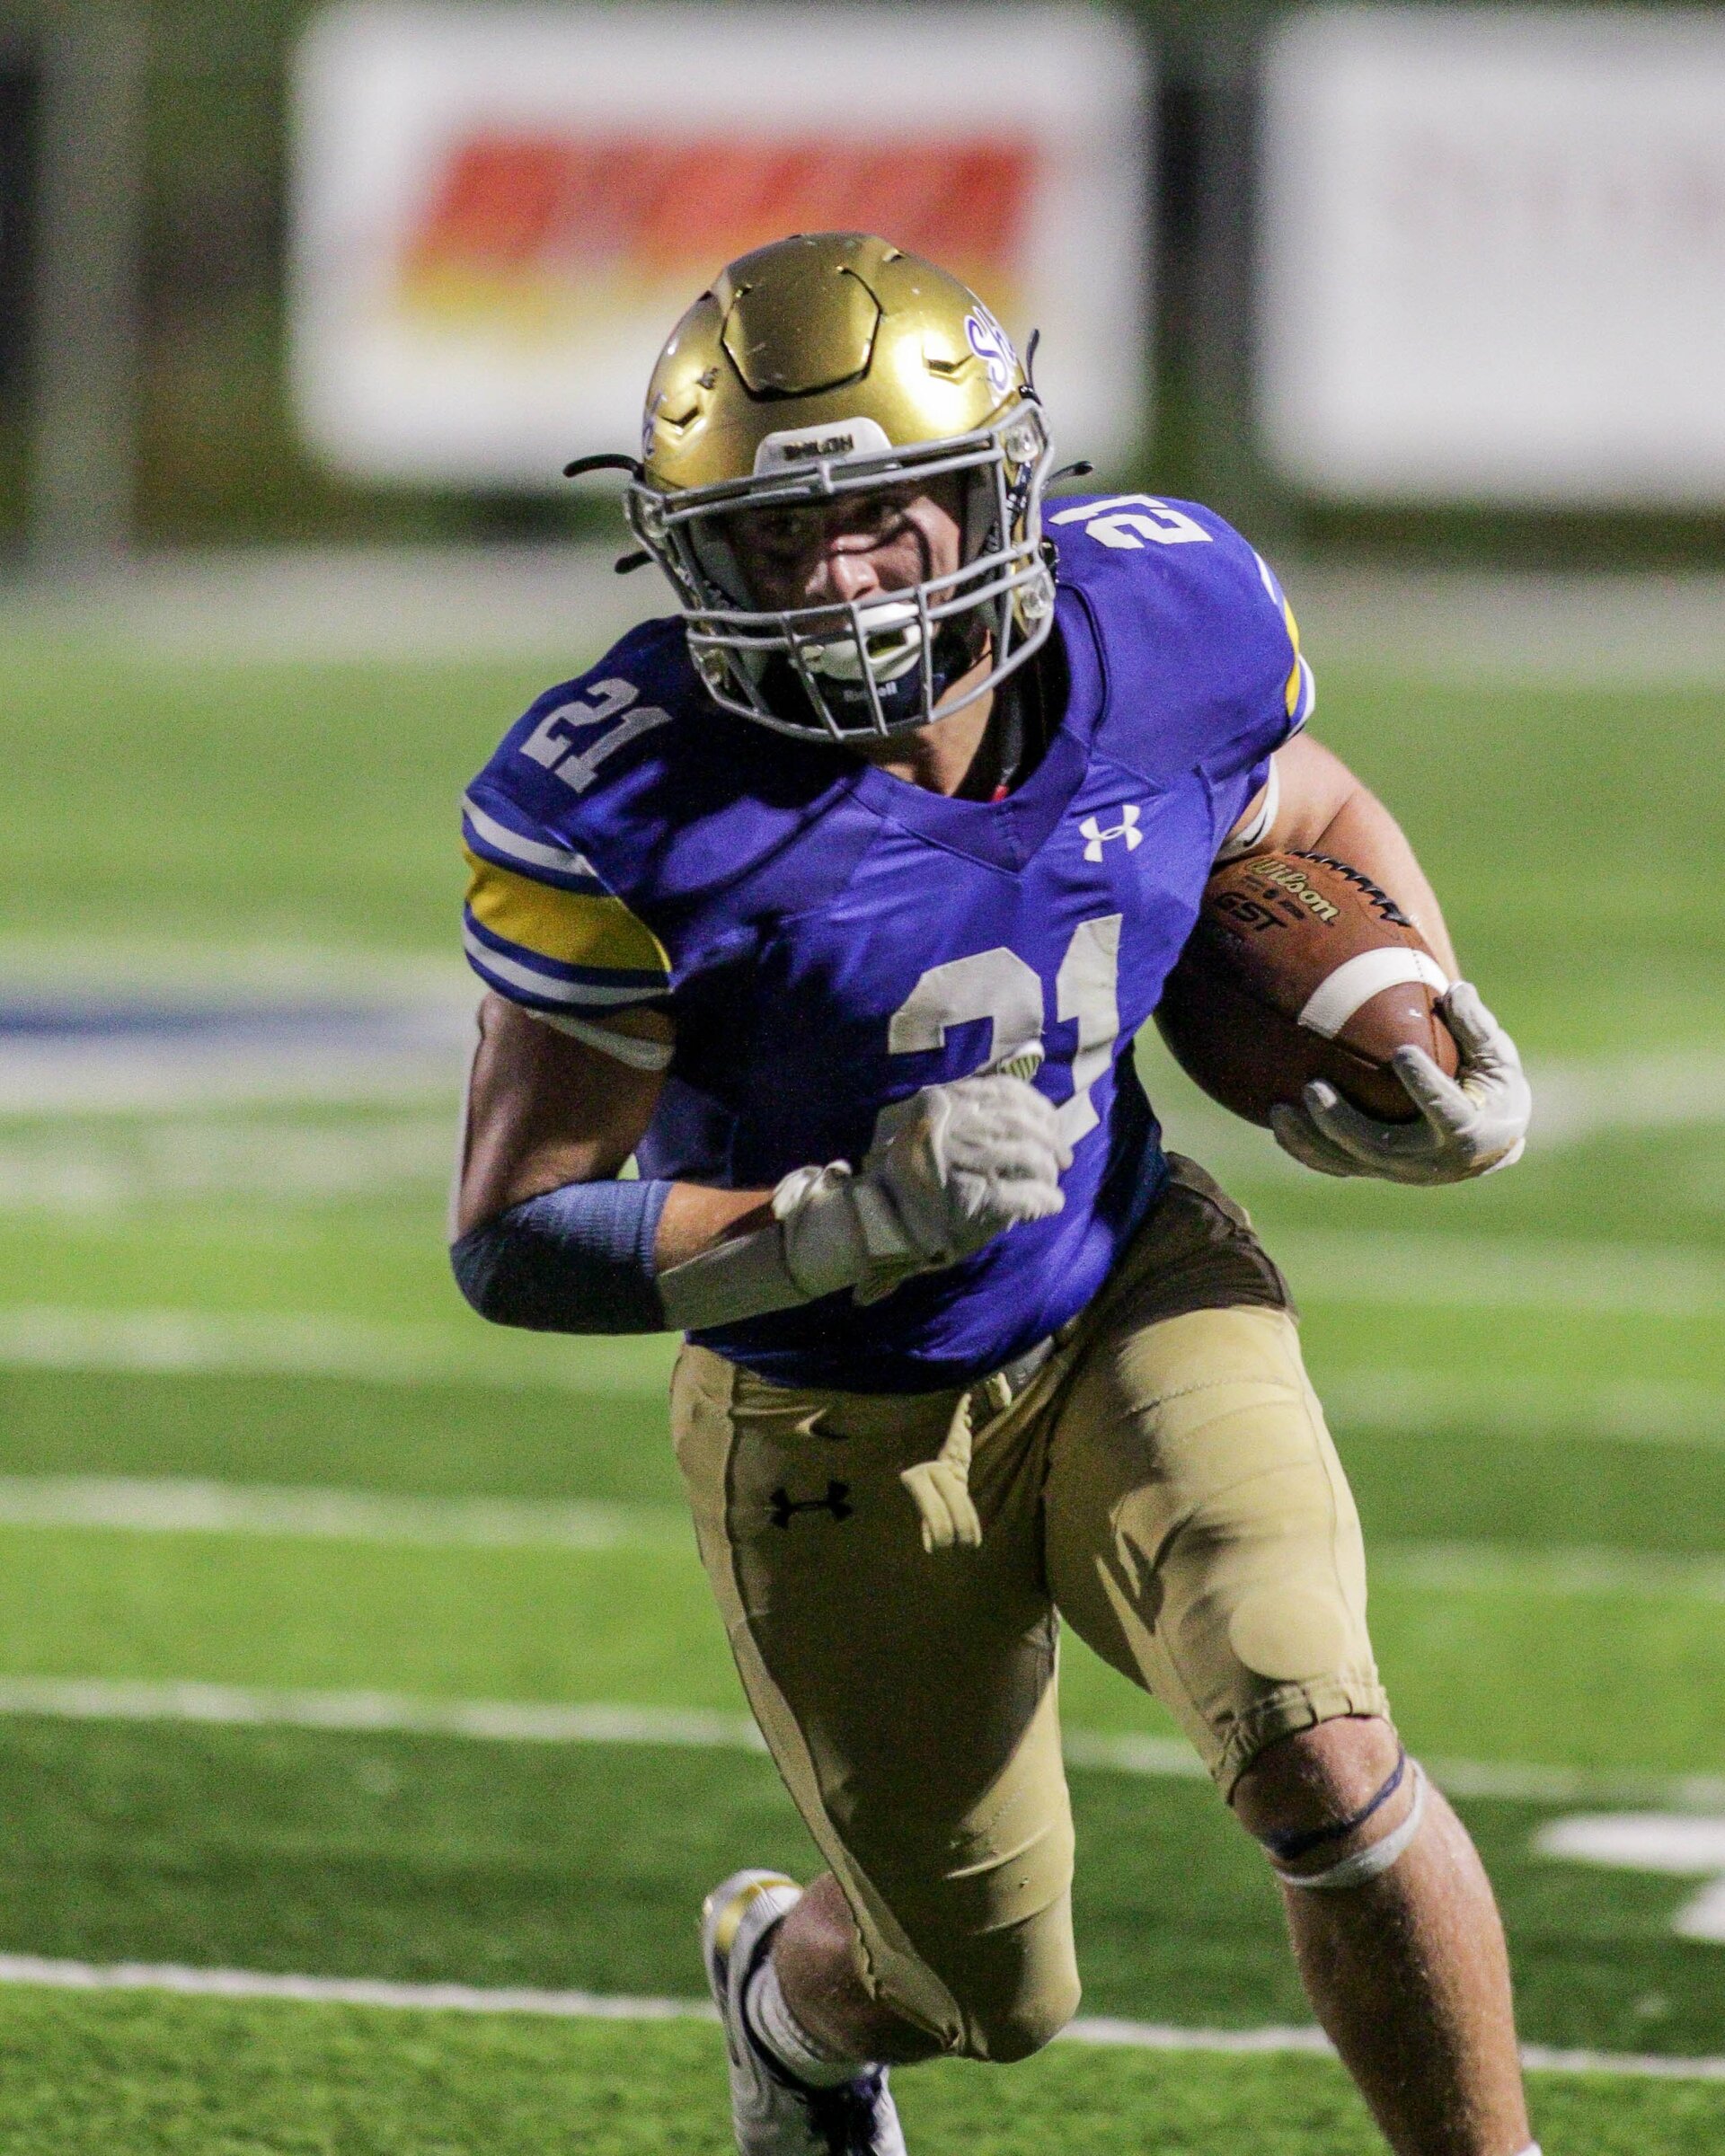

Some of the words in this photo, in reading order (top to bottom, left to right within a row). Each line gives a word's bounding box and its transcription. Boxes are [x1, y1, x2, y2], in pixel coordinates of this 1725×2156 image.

[1048, 494, 1213, 550] 21
[518, 677, 673, 794] 21
[1215, 892, 1287, 932] GST
[1246, 858, 1340, 927] Wilson
[888, 913, 1123, 1149] 21
